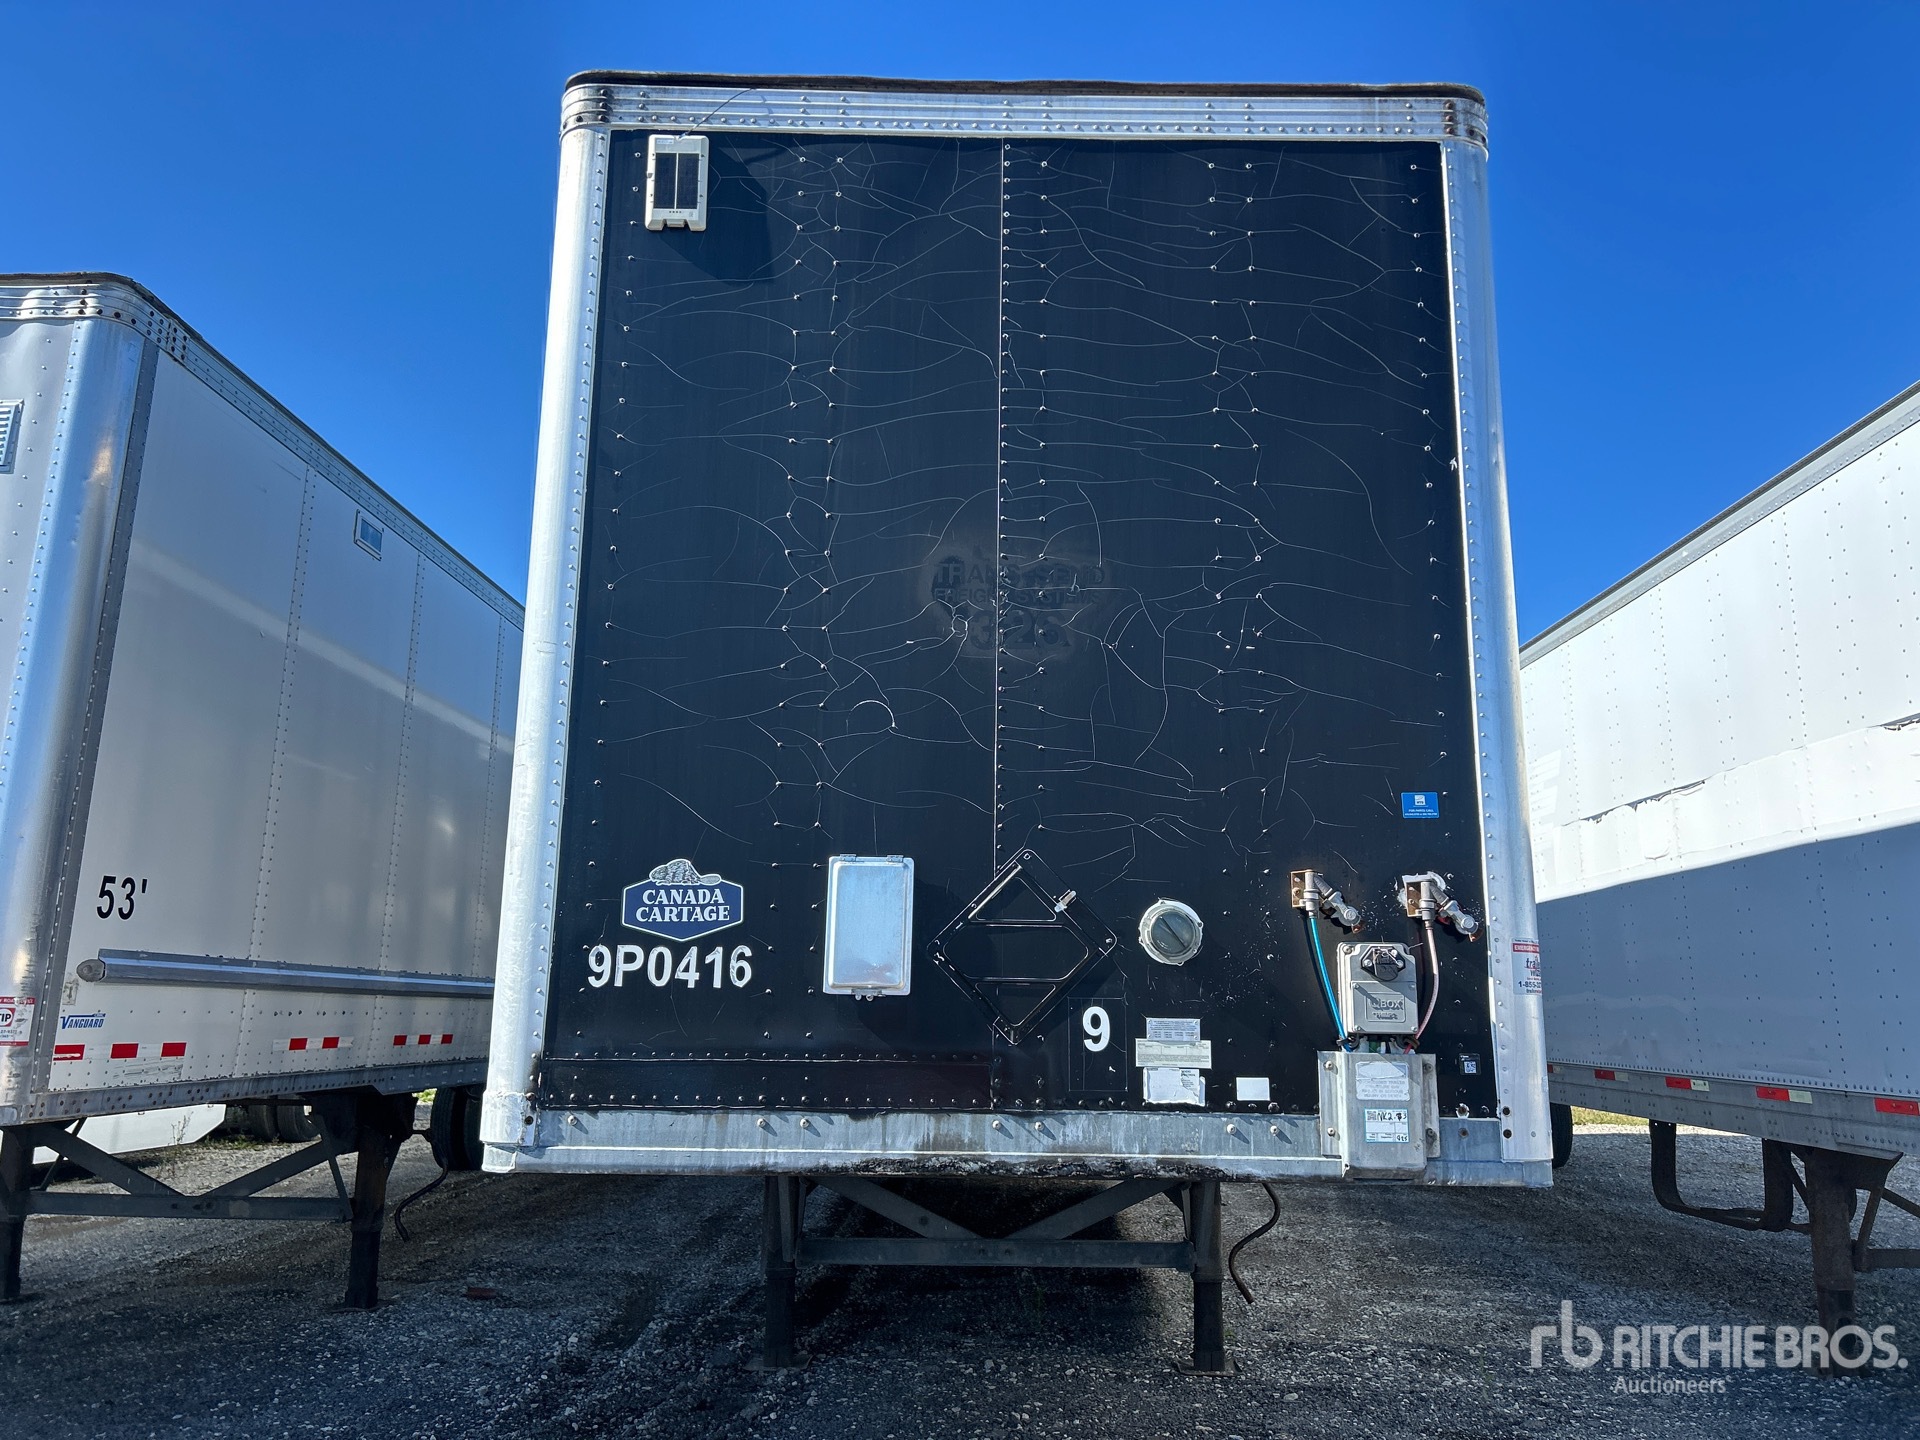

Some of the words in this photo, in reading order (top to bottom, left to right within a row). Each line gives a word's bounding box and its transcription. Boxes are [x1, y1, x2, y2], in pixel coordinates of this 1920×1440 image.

[96, 875, 148, 921] 53'
[642, 888, 725, 905] CANADA
[635, 905, 730, 923] CARTAGE
[587, 944, 753, 989] 9P0416
[60, 1015, 104, 1029] VANGUARD
[1082, 1006, 1111, 1052] 9
